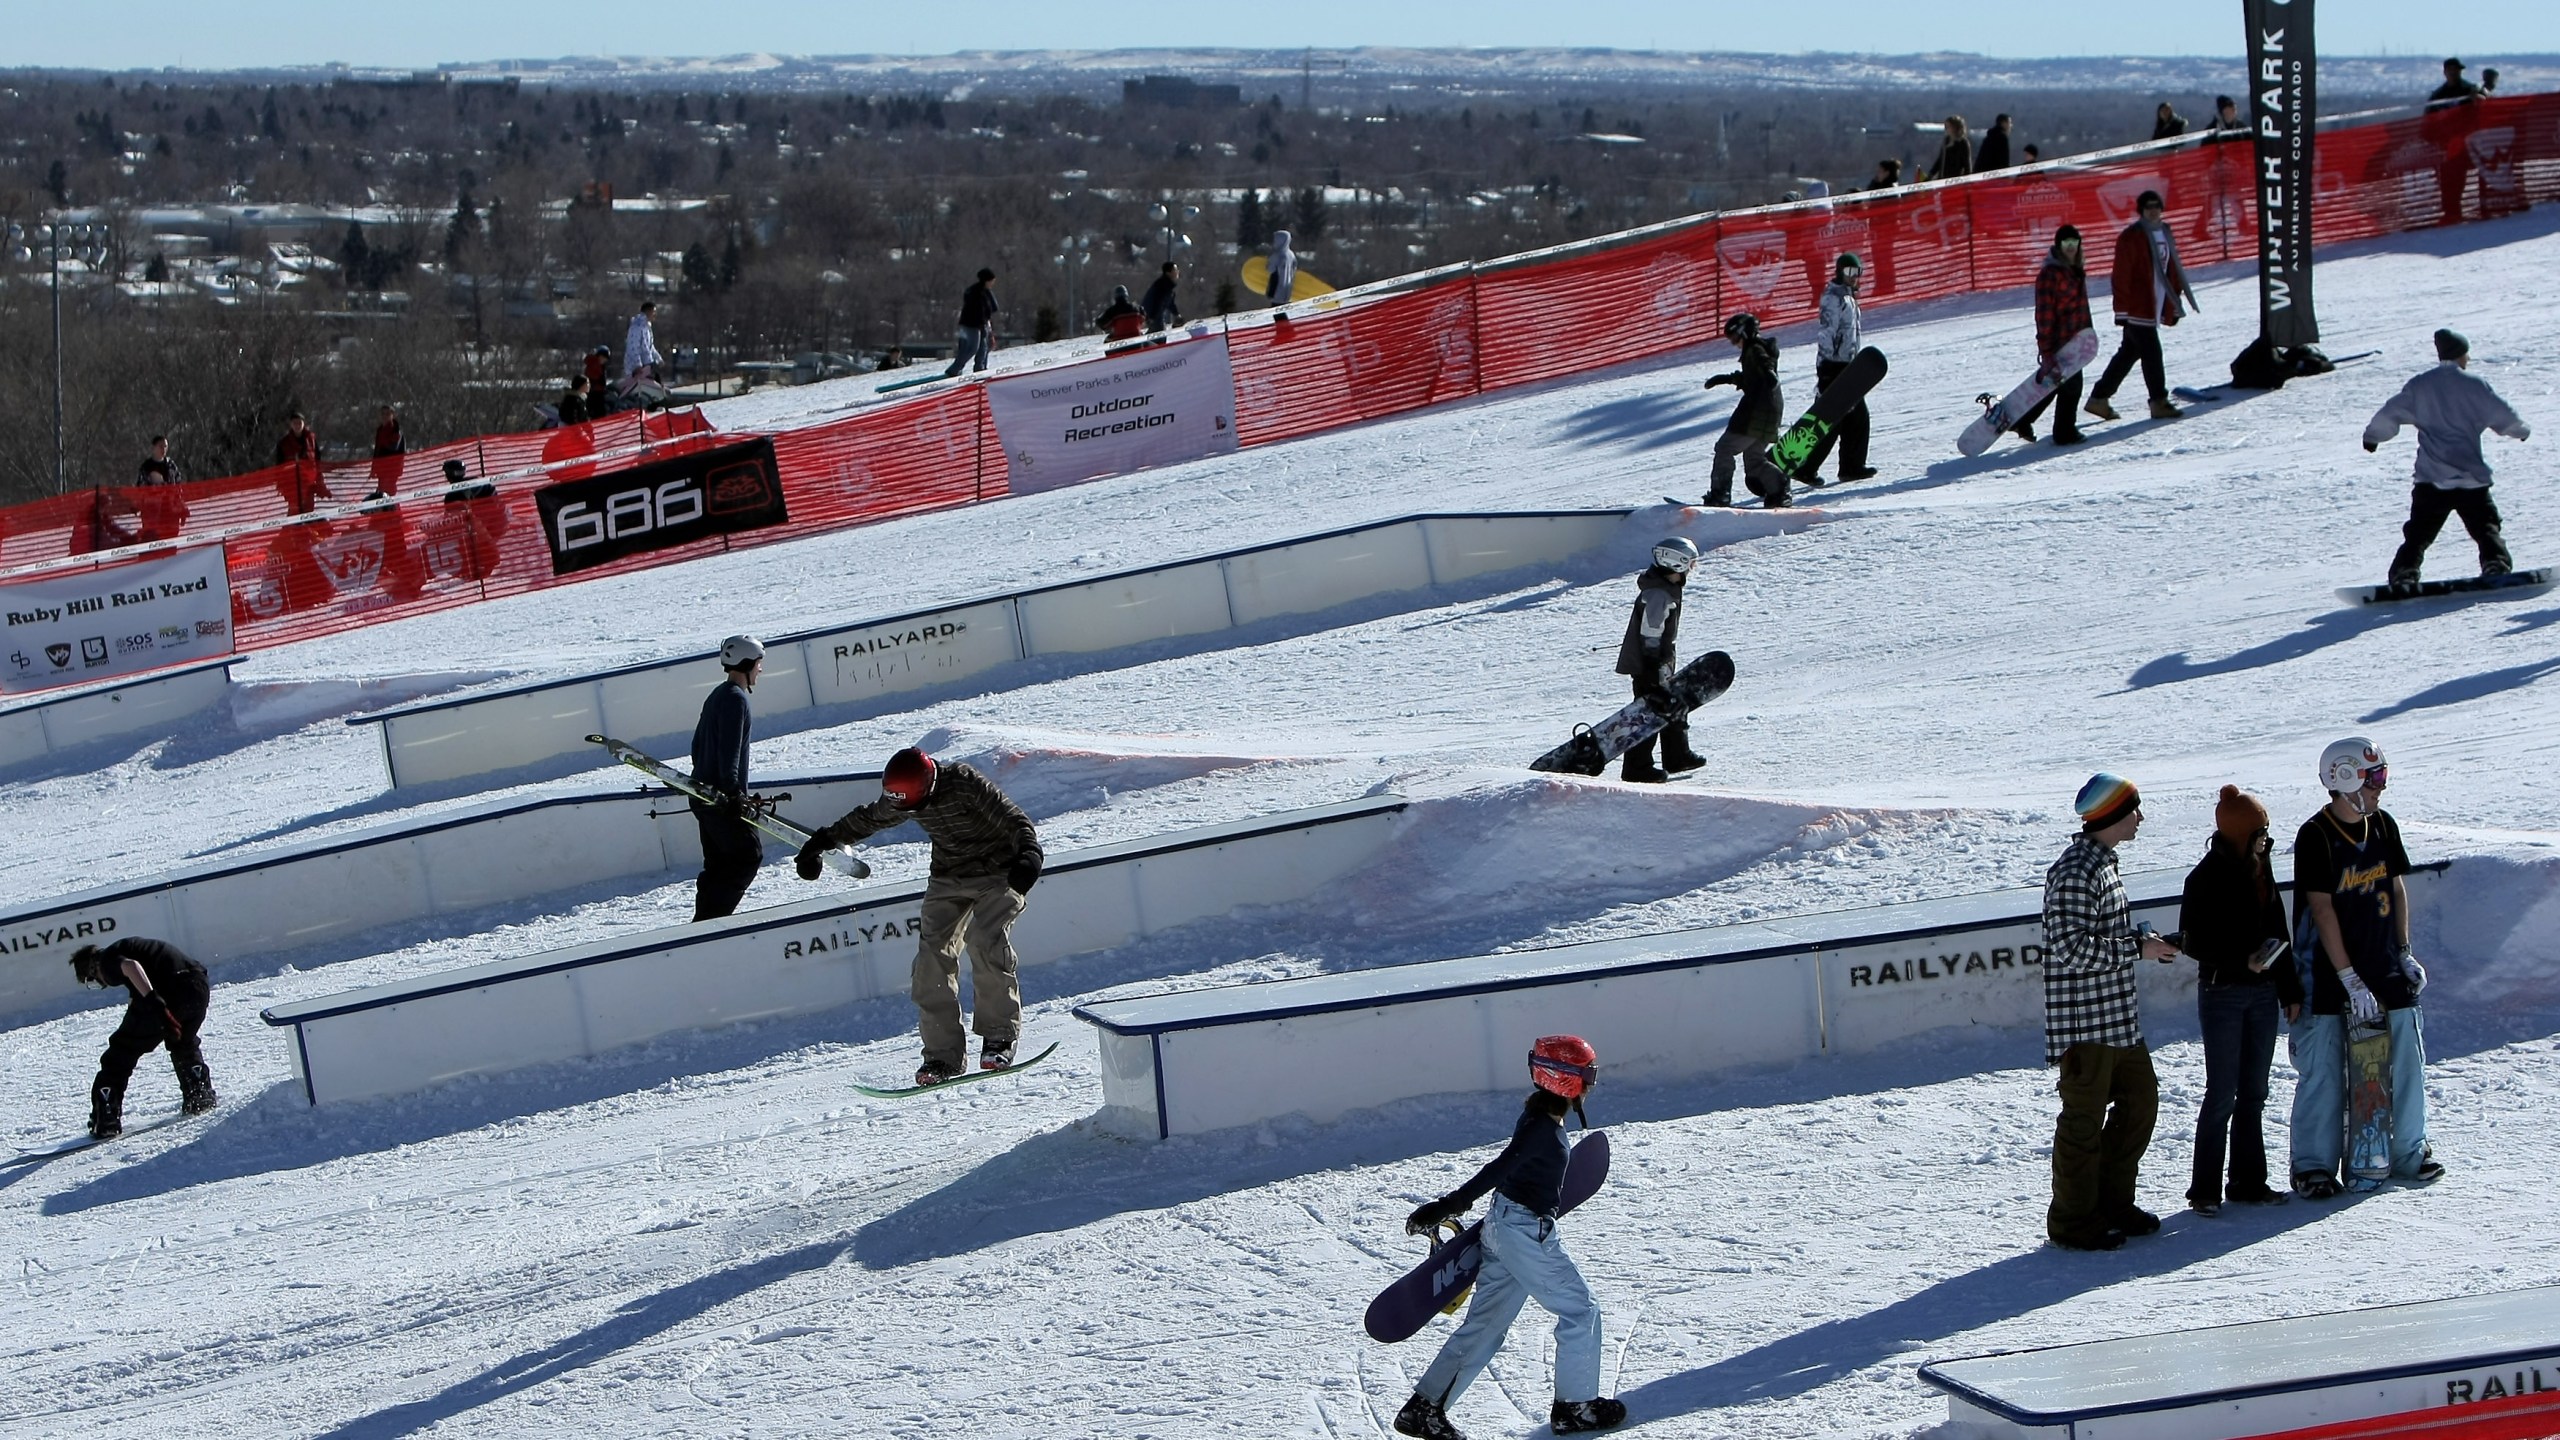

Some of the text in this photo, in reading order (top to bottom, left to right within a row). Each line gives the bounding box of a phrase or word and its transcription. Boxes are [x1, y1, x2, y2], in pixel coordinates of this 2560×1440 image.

[2261, 27, 2291, 311] WINTER PARK
[2291, 60, 2302, 272] AUTHENTIC COLORADO
[1031, 358, 1187, 399] Denver Parks & Recreation
[1071, 394, 1154, 419] Outdoor
[1064, 412, 1175, 443] Recreation
[557, 479, 703, 552] 686
[7, 576, 208, 626] Ruby Hill Rail Yard
[126, 632, 152, 646] SOS
[834, 622, 956, 658] RAILYARD
[85, 660, 110, 668] BURTON
[2336, 860, 2387, 895] Nugget
[2377, 891, 2391, 918] 3
[1850, 944, 2043, 987] RAILYARD
[2447, 1367, 2560, 1405] RAIL
